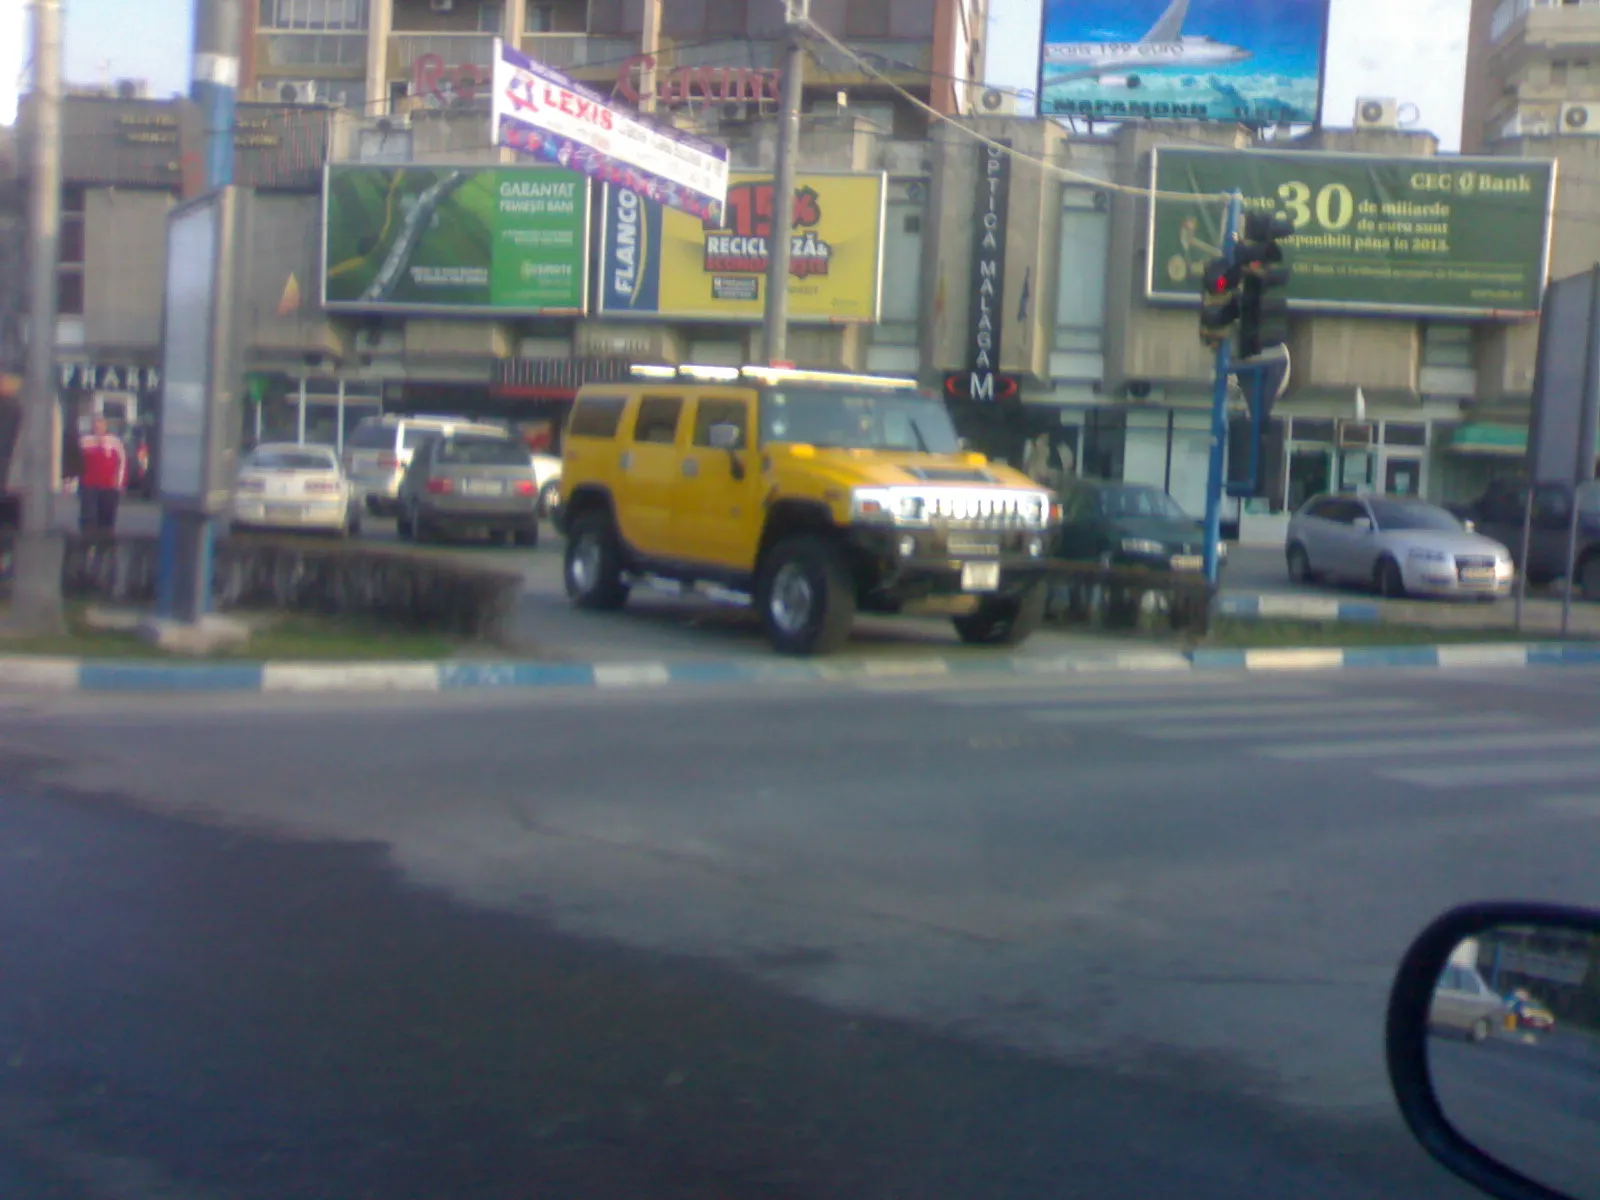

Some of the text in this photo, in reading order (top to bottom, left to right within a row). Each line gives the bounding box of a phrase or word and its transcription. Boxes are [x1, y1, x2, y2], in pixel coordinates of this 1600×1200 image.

[543, 86, 614, 131] LEXIS
[500, 182, 575, 197] GARANTAT
[1276, 180, 1353, 230] 30
[1410, 173, 1532, 193] CEC Bank
[615, 188, 637, 294] FLANCO
[976, 143, 1001, 369] OPTICA MALAGA
